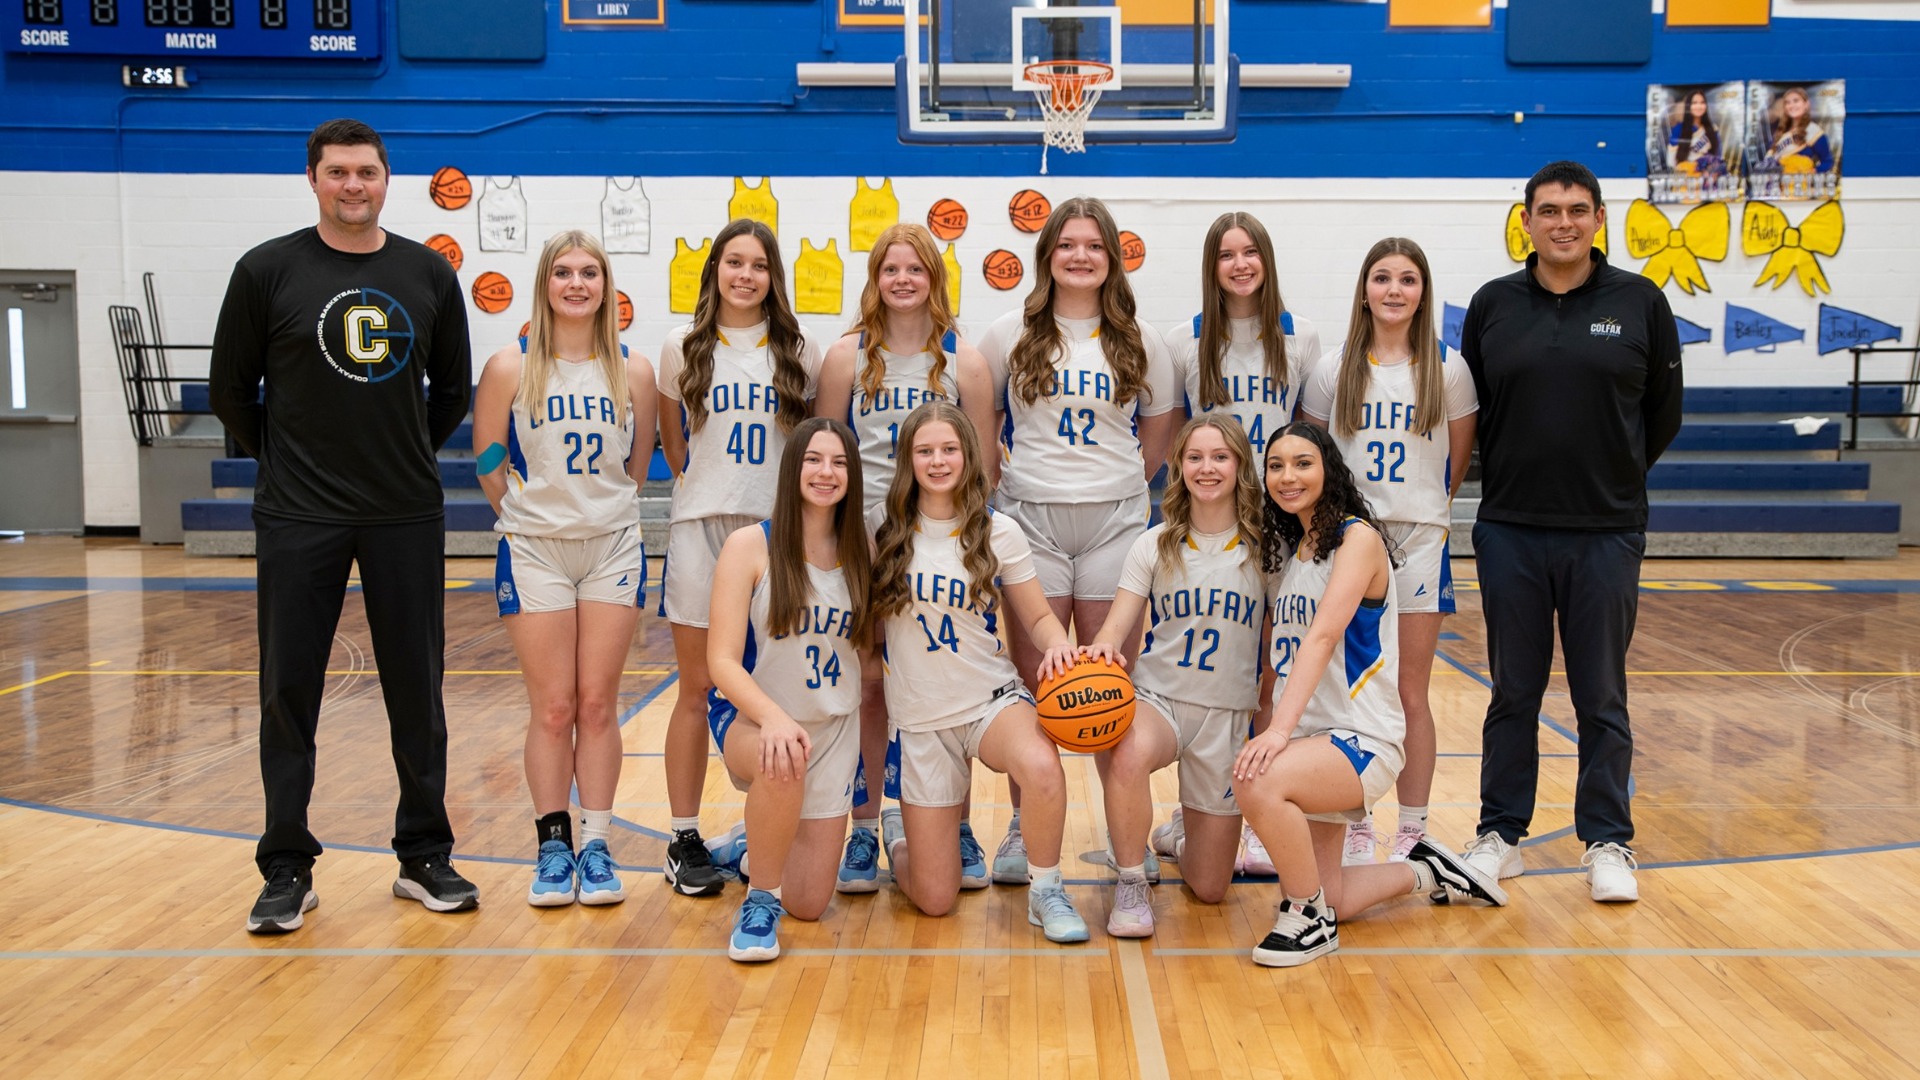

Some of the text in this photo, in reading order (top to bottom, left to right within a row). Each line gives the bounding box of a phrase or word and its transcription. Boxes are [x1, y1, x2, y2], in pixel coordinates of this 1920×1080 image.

[597, 3, 630, 16] LIBEY
[20, 29, 70, 46] SCORE
[165, 33, 217, 49] MATCH
[309, 35, 357, 51] SCORE
[142, 67, 173, 84] 2:56
[1023, 203, 1043, 217] #12
[998, 261, 1020, 277] #33
[317, 287, 369, 383] COLFAX HIGH SCHOOL BASKETBALL
[343, 305, 390, 363] C
[1590, 323, 1622, 335] COLFAX
[1734, 319, 1773, 339] Bailey
[1824, 315, 1872, 342] Jocelyn
[703, 382, 780, 416] OLFA
[859, 386, 949, 418] COLF
[1201, 374, 1290, 413] LFAX
[529, 393, 628, 434] OLFA
[1057, 407, 1099, 446] 42
[1357, 401, 1432, 442] OLF
[726, 421, 767, 466] 40
[1231, 413, 1266, 454] 4
[563, 431, 604, 475] 22
[1365, 440, 1406, 483] 32
[905, 572, 982, 616] LFAX
[1161, 587, 1258, 629] COLFAX
[1272, 593, 1317, 628] OLFA
[774, 605, 854, 641] OLFA
[916, 613, 960, 654] 14
[805, 644, 842, 690] 34
[1176, 627, 1220, 672] 12
[1056, 687, 1124, 711] Wilson
[1077, 719, 1118, 739] EVO
